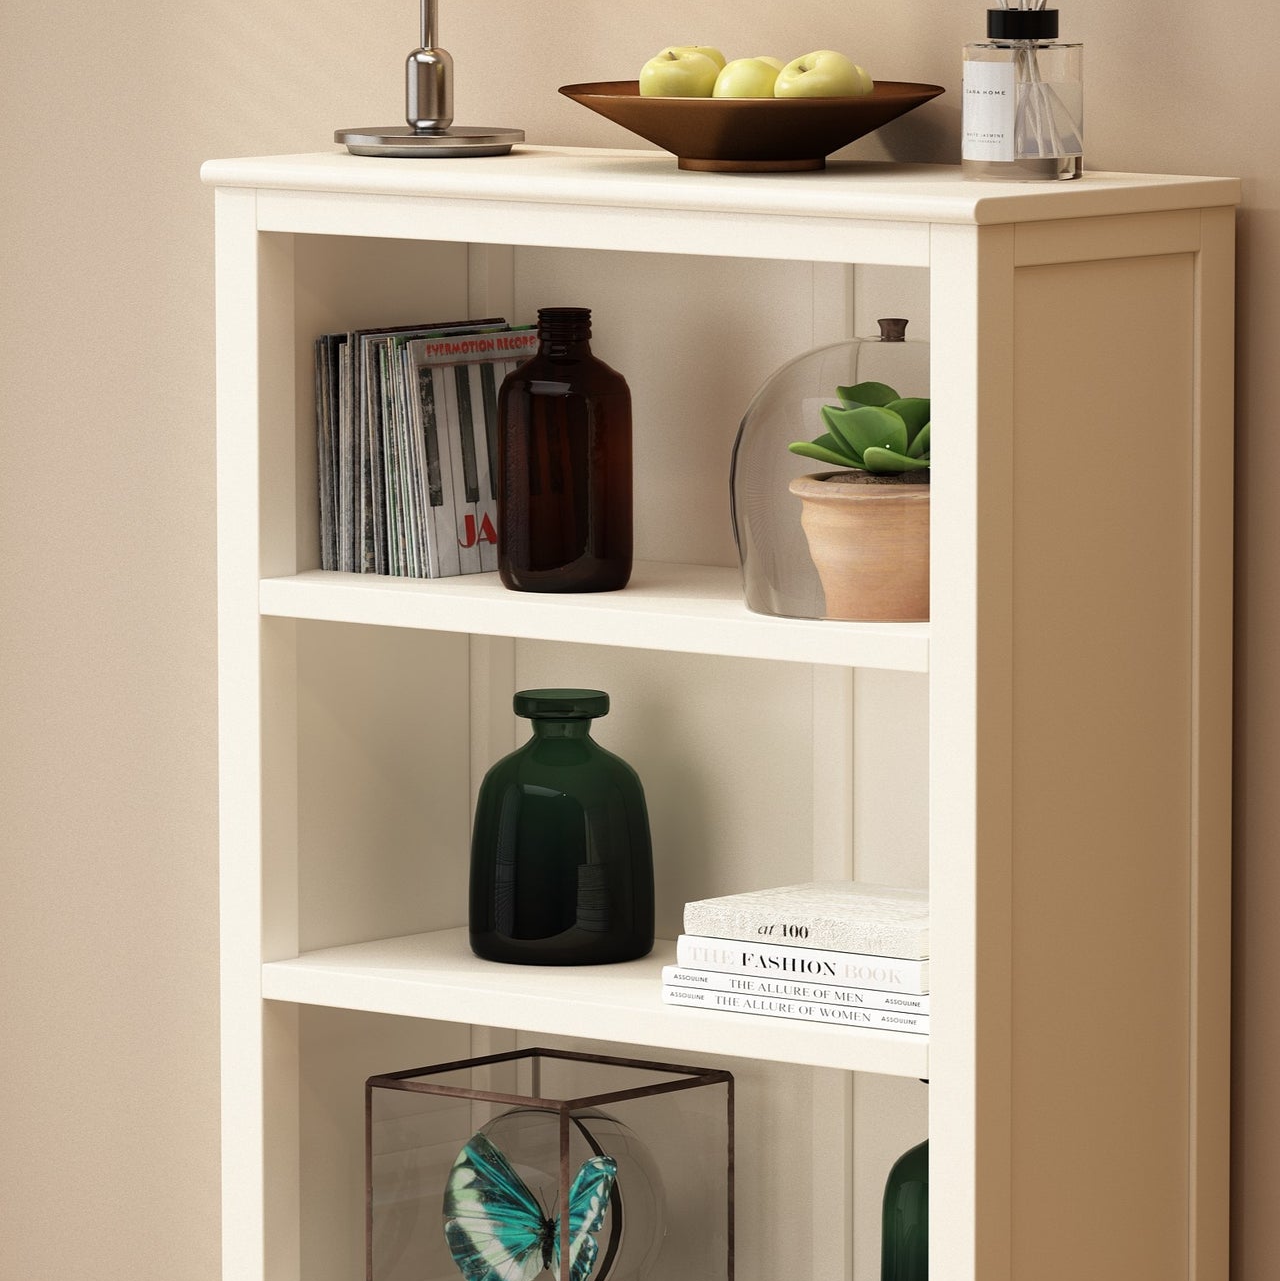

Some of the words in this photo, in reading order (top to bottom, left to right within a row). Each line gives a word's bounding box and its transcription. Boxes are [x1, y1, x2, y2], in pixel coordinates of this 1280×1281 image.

[426, 339, 494, 357] EVERMOTION
[757, 924, 775, 935] at
[781, 924, 809, 939] 100
[688, 946, 735, 965] THE
[742, 952, 837, 976] FASHION
[844, 964, 904, 984] BOOK
[673, 973, 708, 983] ASSOULINE
[669, 991, 704, 1001] ASSOULINE
[729, 978, 754, 991] THE
[758, 983, 810, 997] ALLURE
[813, 989, 831, 999] OF
[834, 991, 863, 1003] MEN
[715, 995, 740, 1007] THE
[743, 999, 795, 1014] ALLURE
[798, 1005, 816, 1015] OF
[819, 1007, 871, 1022] WOMEN
[884, 998, 920, 1007] ASSOULINE
[881, 1016, 917, 1025] ASSOULINE
